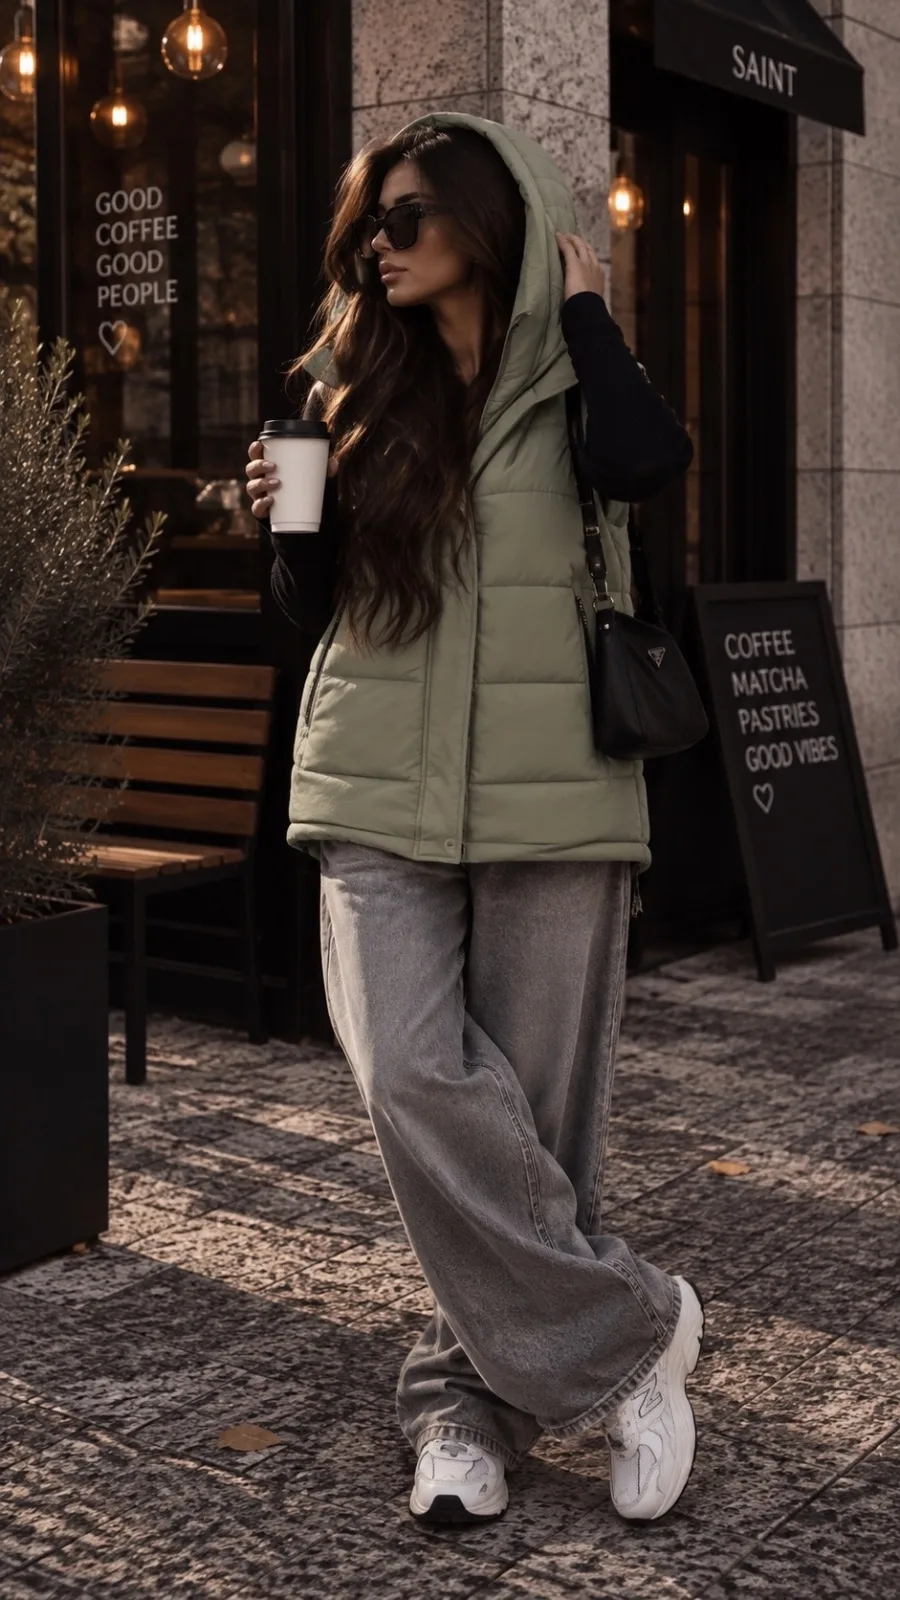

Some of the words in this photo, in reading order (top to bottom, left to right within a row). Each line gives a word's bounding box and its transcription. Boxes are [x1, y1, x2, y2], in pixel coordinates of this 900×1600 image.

[732, 44, 798, 98] SAINT
[95, 186, 163, 215] GOOD
[96, 215, 179, 246] COFFEE
[96, 249, 164, 277] GOOD
[97, 279, 179, 308] PEOPLE
[724, 629, 796, 660] COFFEE
[731, 666, 809, 697] MATCHA
[737, 701, 820, 735] PASTRIES
[745, 741, 793, 772] GOOD
[793, 735, 839, 764] VIBES
